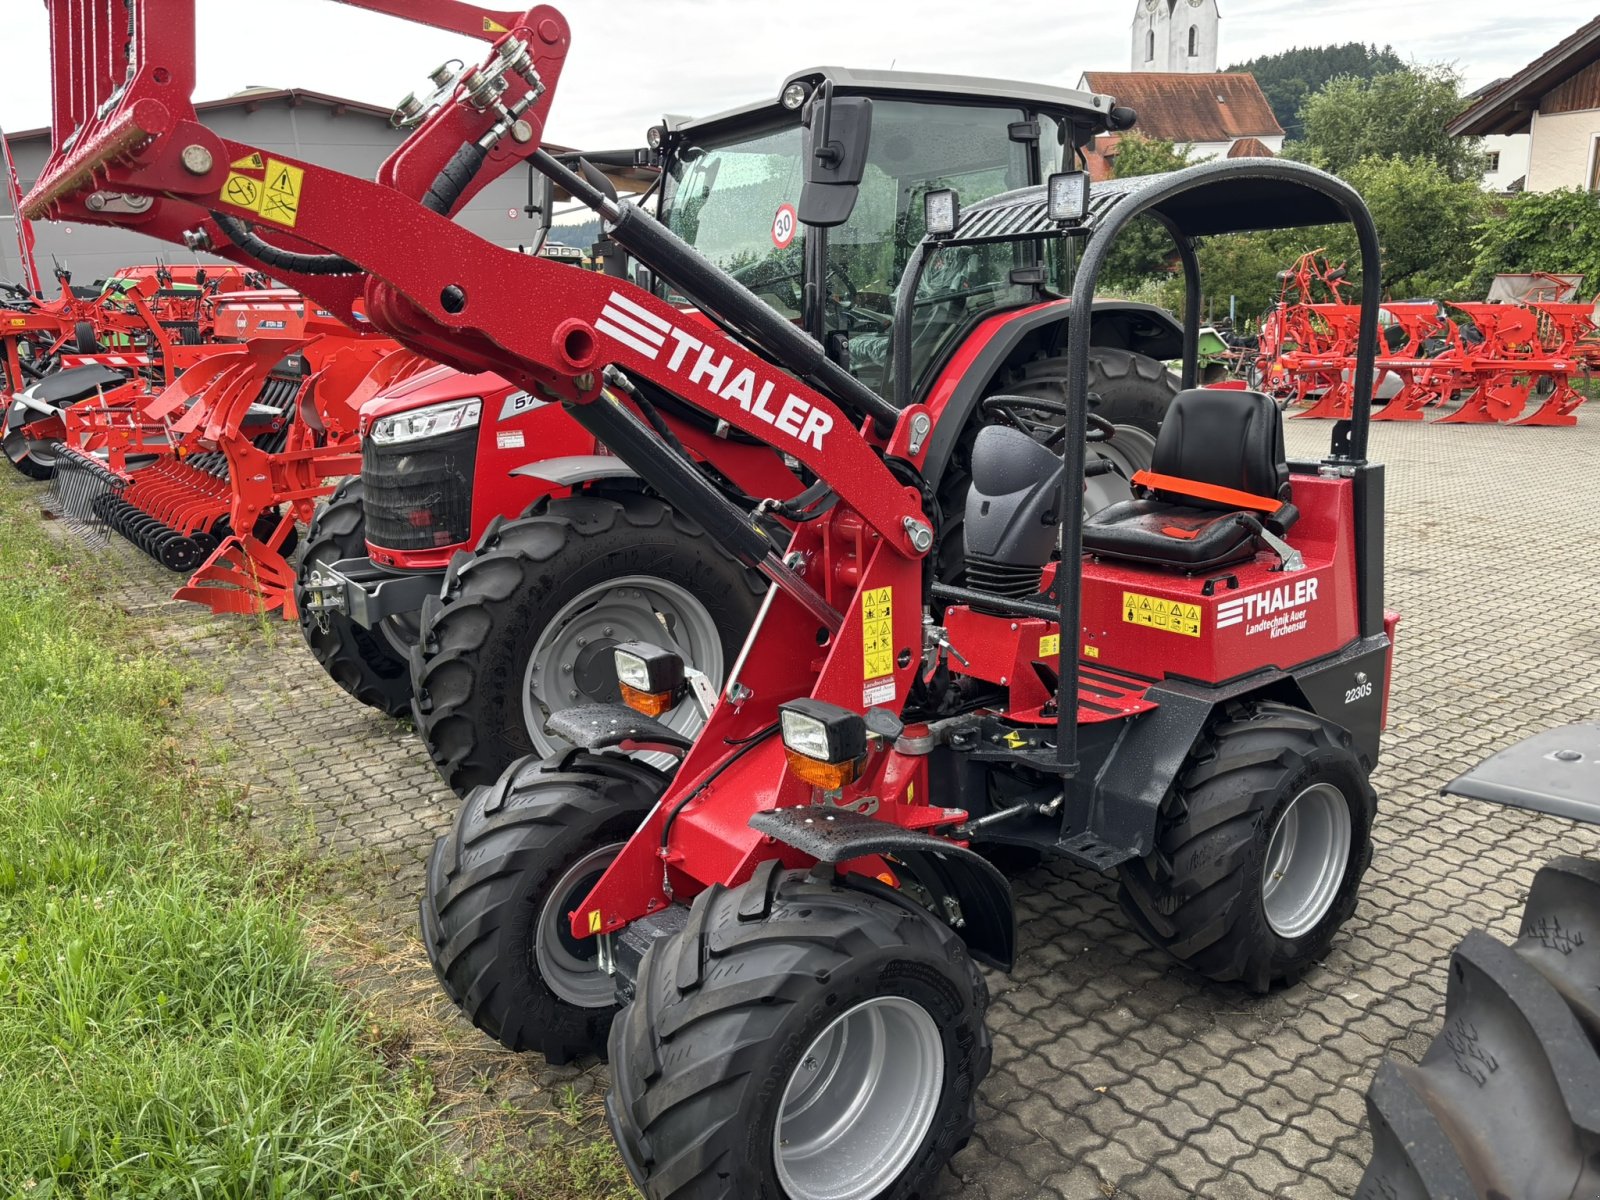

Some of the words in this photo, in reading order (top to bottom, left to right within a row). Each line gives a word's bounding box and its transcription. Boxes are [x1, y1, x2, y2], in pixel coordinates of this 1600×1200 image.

[776, 214, 791, 237] 30
[667, 326, 834, 451] THALER
[1243, 577, 1318, 620] THALER
[1245, 613, 1289, 636] Landtechnik
[1290, 609, 1307, 622] Auer
[1270, 620, 1307, 639] Kirchensur
[1344, 682, 1372, 704] 2230S
